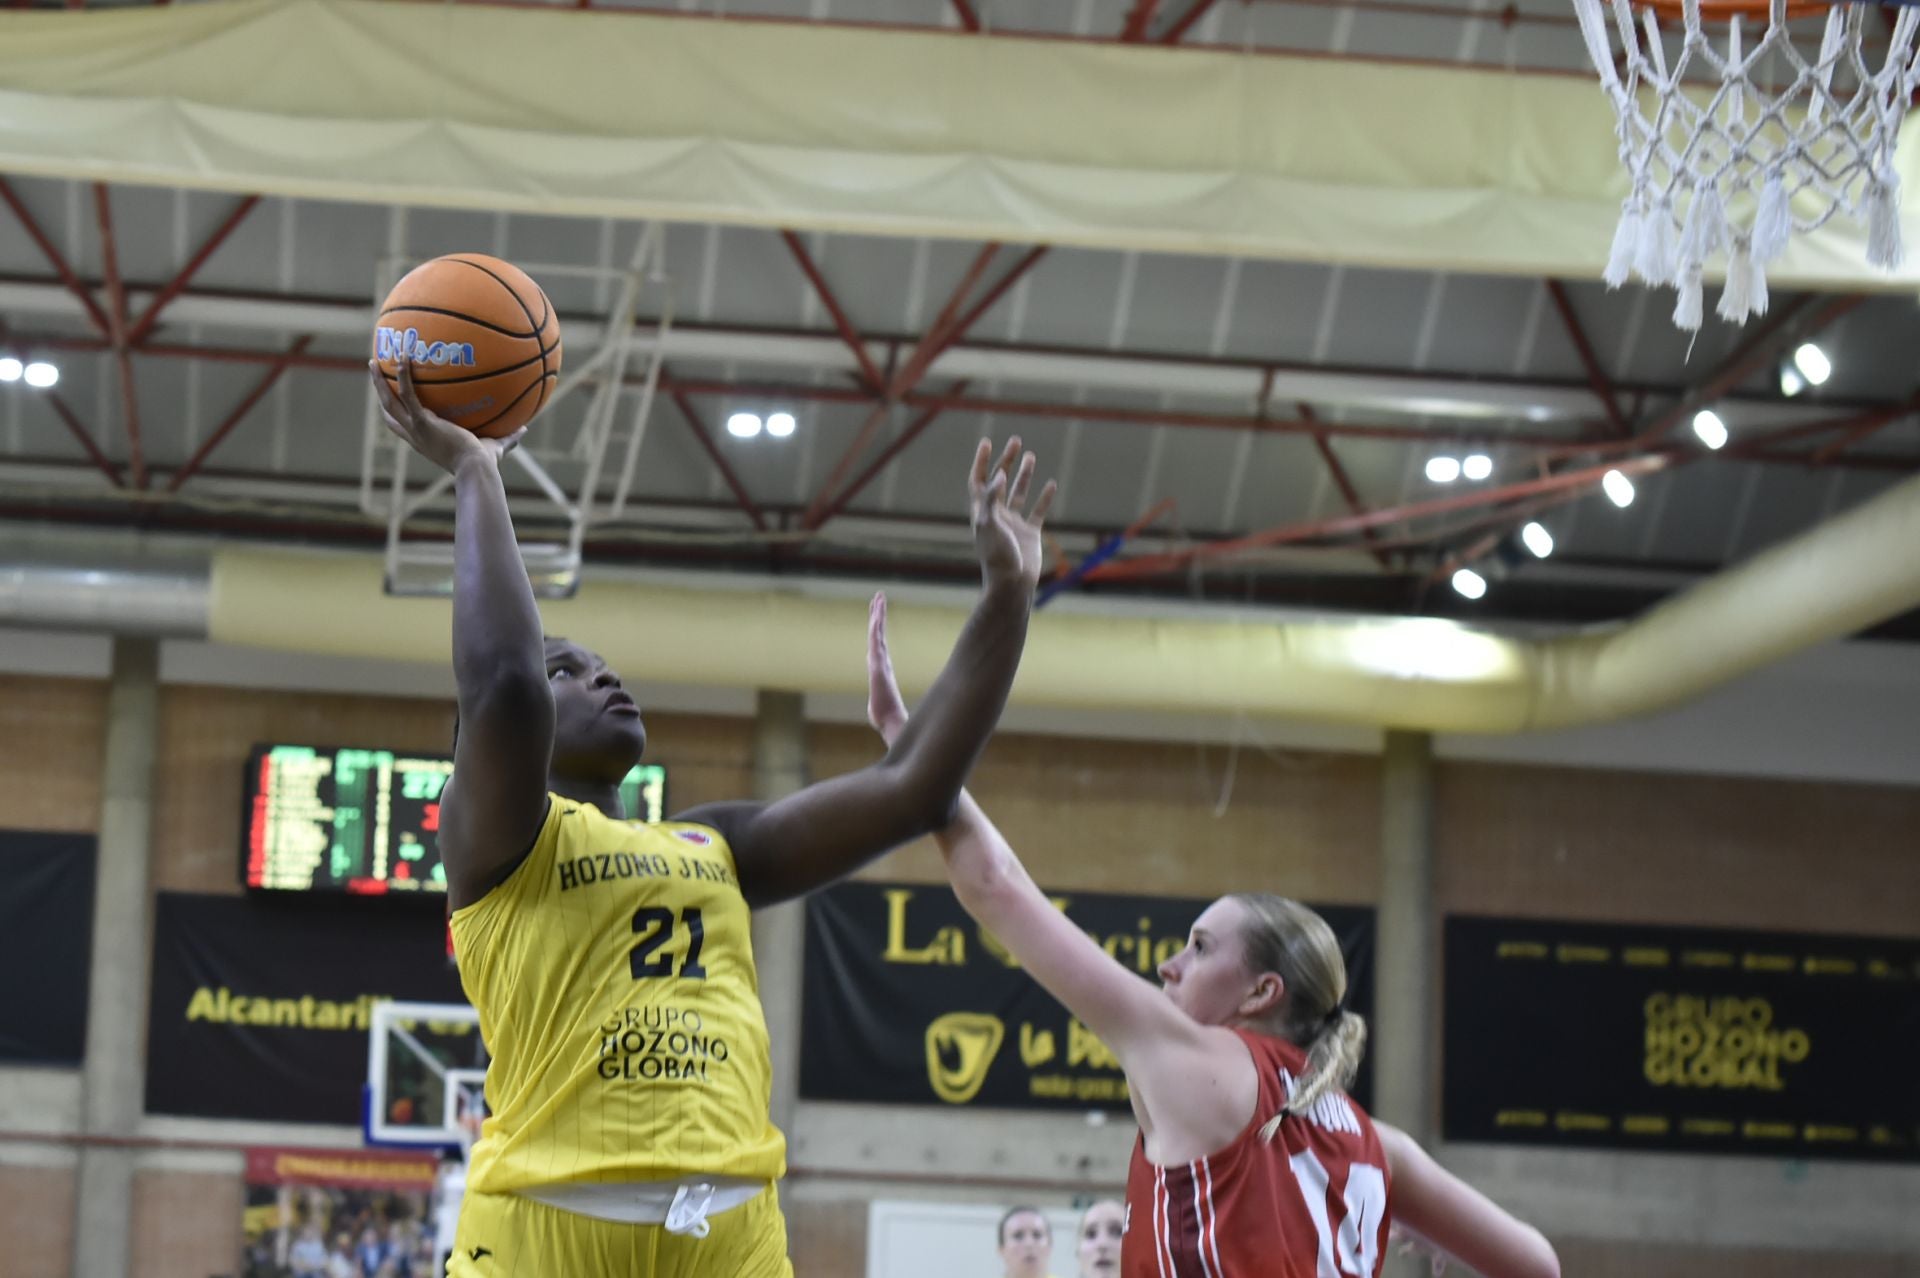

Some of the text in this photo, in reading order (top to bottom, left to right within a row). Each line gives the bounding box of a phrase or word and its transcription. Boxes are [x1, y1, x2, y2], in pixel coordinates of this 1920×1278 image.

[376, 326, 476, 366] Wilson
[558, 853, 670, 890] HOZONO
[629, 906, 707, 980] 21
[884, 890, 966, 966] La
[186, 986, 416, 1031] Alcantari
[600, 1005, 702, 1036] GRUPO
[599, 1029, 729, 1062] HOZONO
[597, 1055, 708, 1081] GLOBAL
[1288, 1147, 1387, 1278] 14
